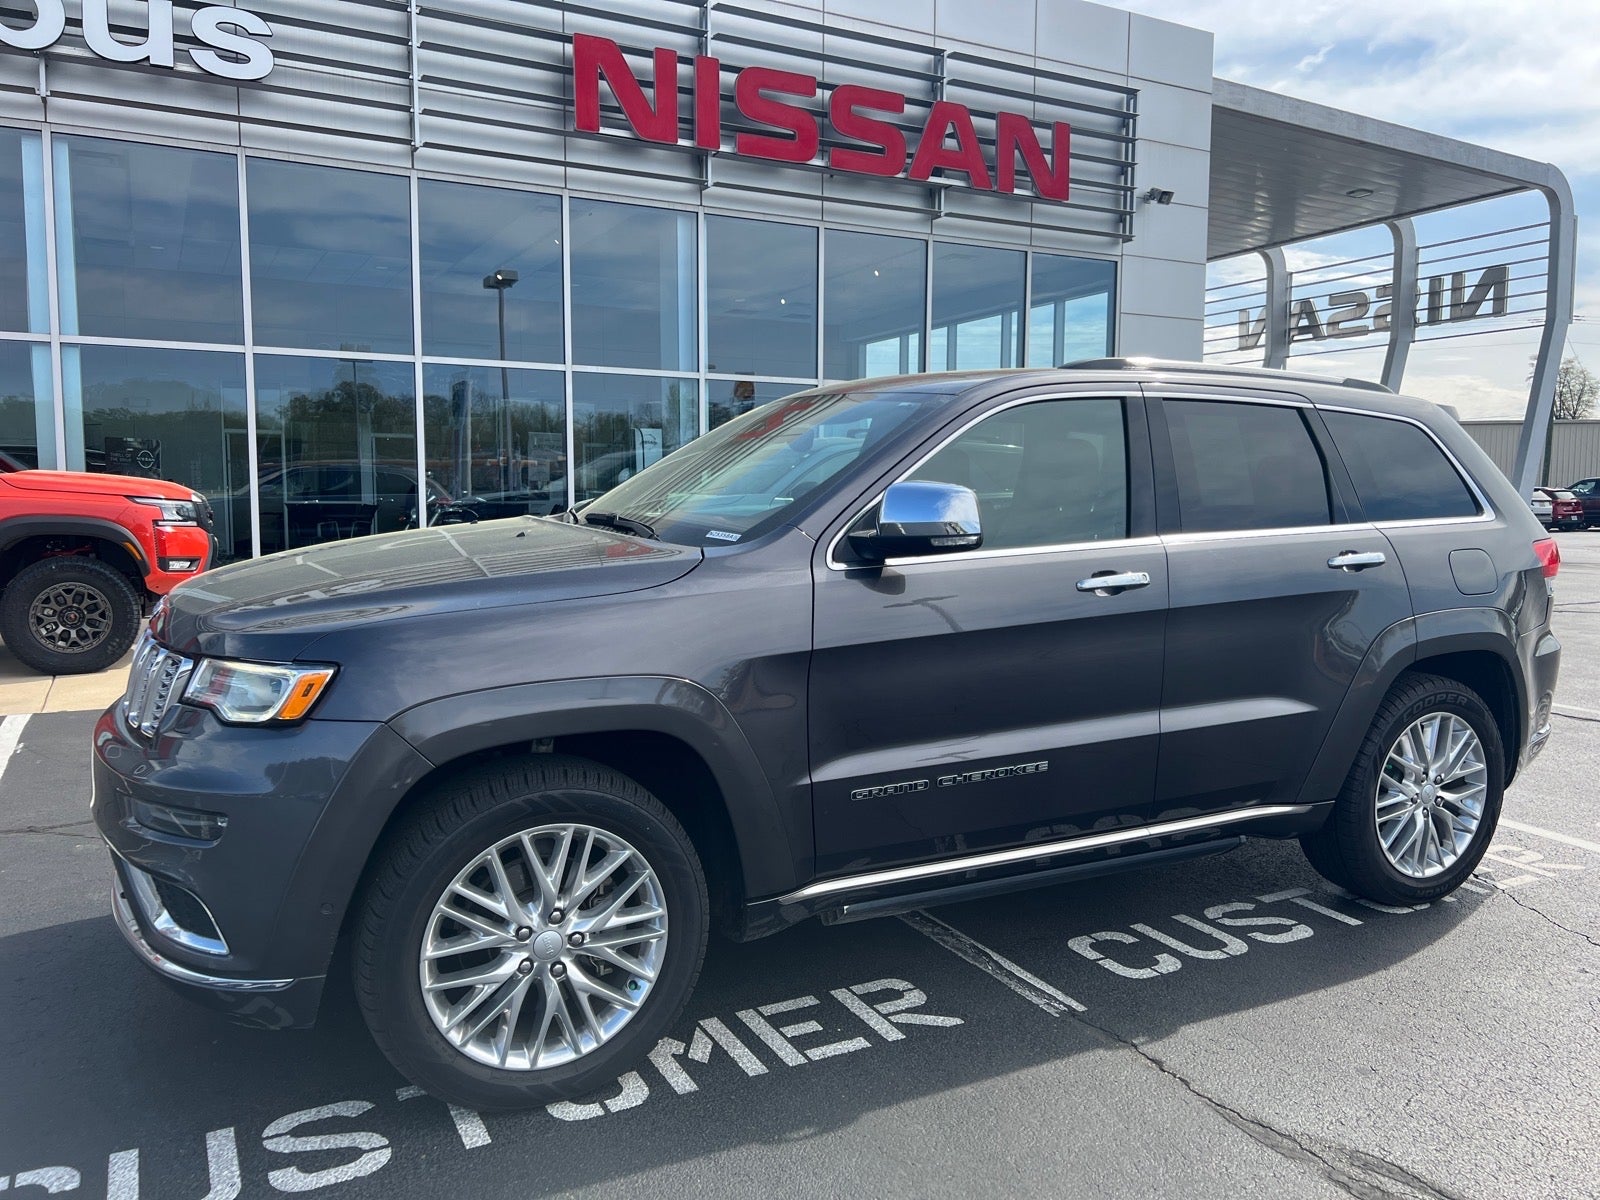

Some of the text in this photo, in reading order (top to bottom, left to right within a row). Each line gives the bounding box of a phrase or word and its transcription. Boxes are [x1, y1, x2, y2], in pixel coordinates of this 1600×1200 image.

[572, 33, 1070, 201] NISSAN
[1403, 693, 1468, 723] COOPER
[851, 761, 1049, 801] GRAND CHEROKEE
[1066, 843, 1586, 980] CUSTER
